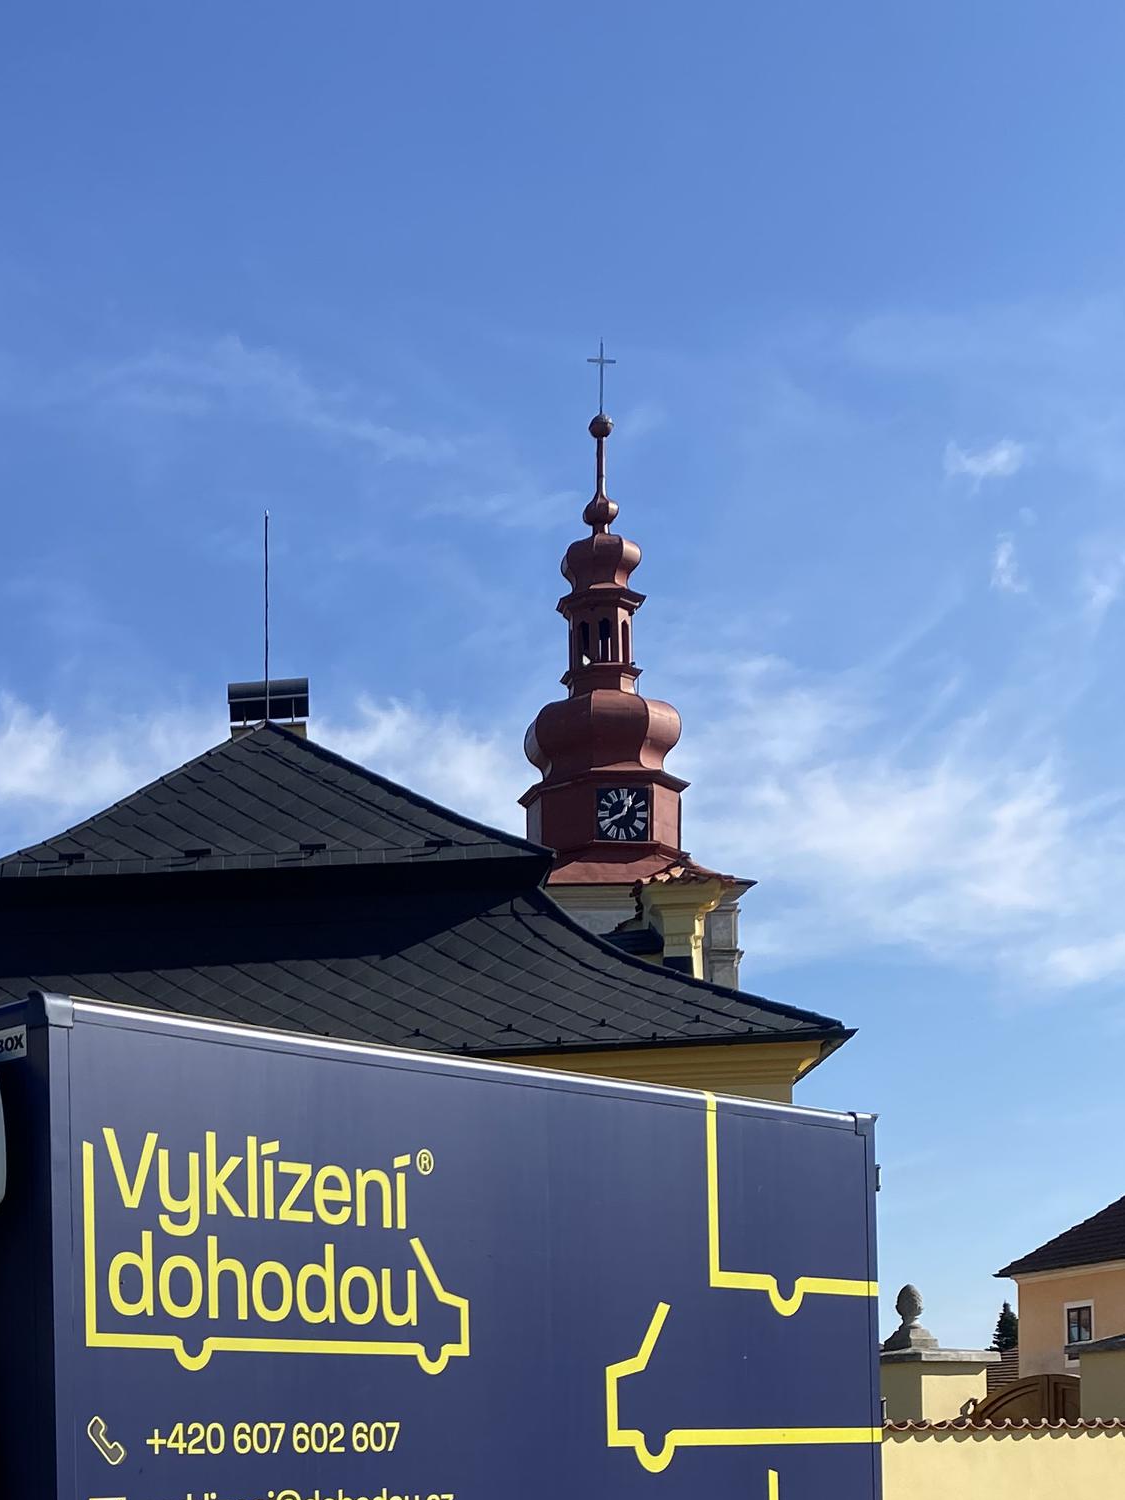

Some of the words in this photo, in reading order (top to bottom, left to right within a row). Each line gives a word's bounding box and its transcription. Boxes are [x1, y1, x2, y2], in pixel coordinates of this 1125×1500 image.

[108, 1230, 418, 1327] dohodou
[146, 1421, 225, 1455] +420
[232, 1421, 285, 1454] 607
[292, 1421, 345, 1454] 602
[351, 1421, 400, 1453] 607
